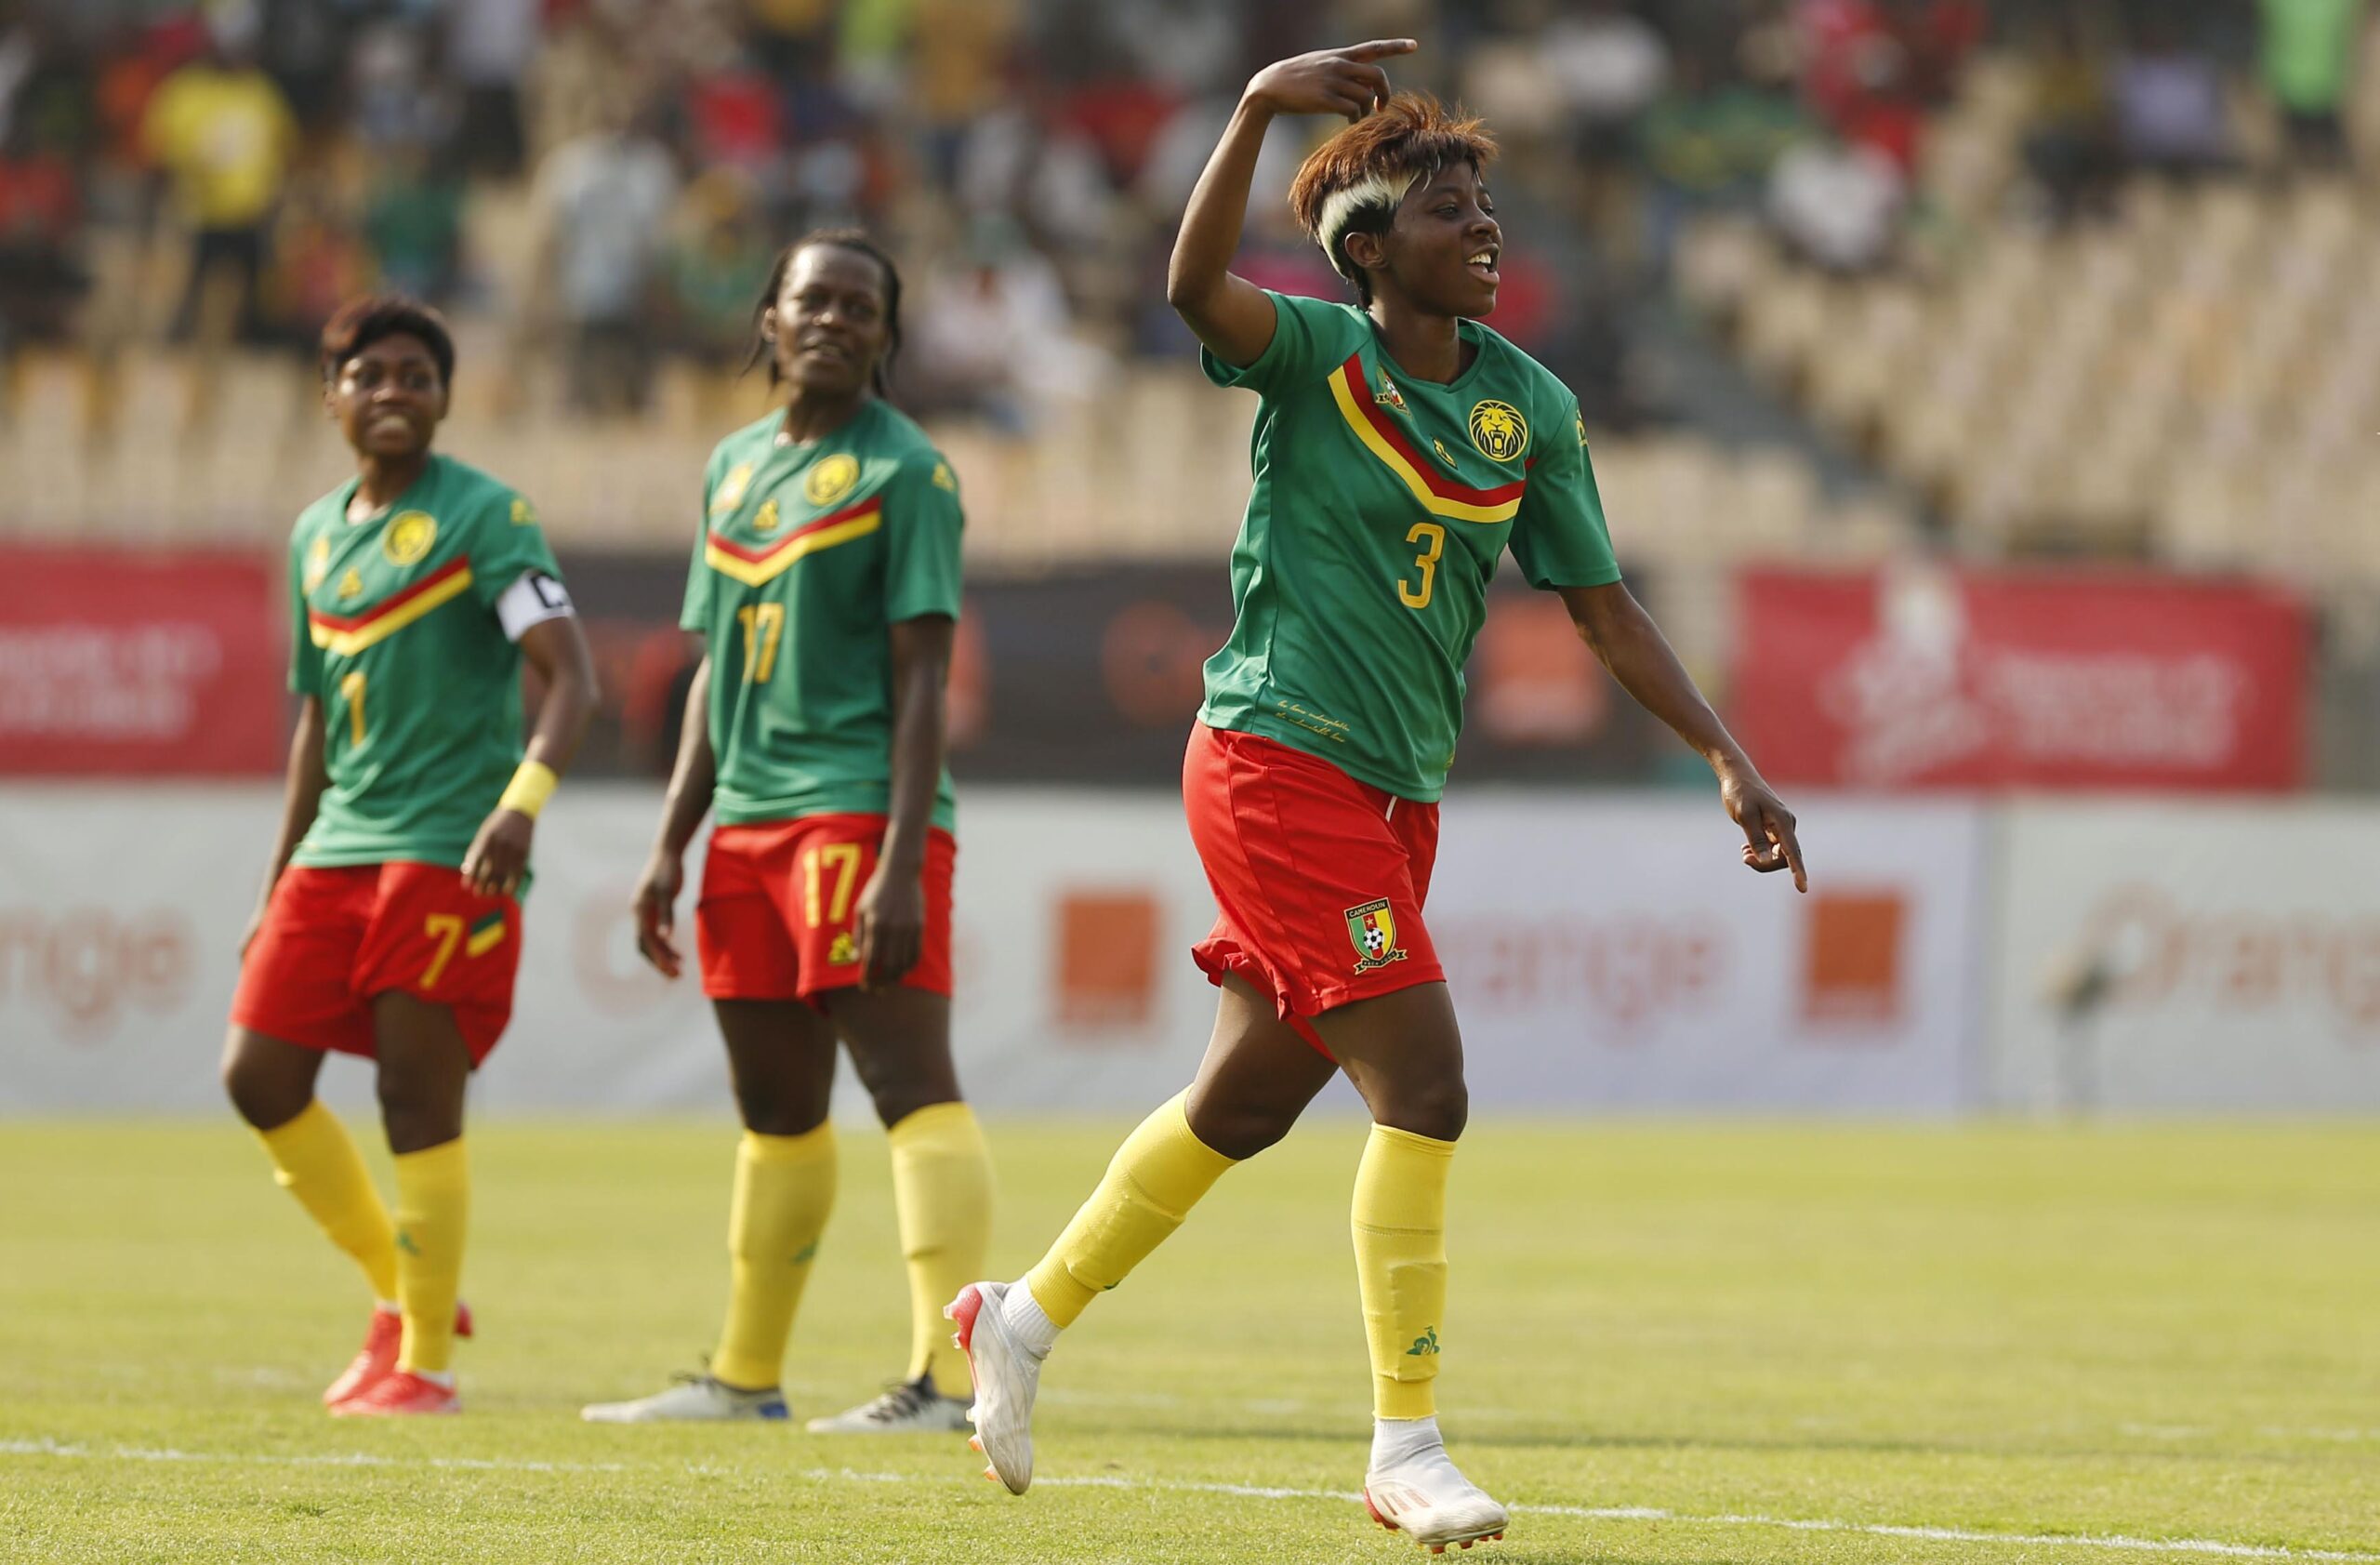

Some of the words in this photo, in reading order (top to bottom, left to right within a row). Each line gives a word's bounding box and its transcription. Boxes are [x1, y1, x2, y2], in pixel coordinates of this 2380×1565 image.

[1397, 523, 1445, 609] 3
[738, 602, 785, 684] 17
[802, 842, 861, 929] 17
[1349, 901, 1386, 918] CAMEROUN
[420, 913, 463, 989] 7
